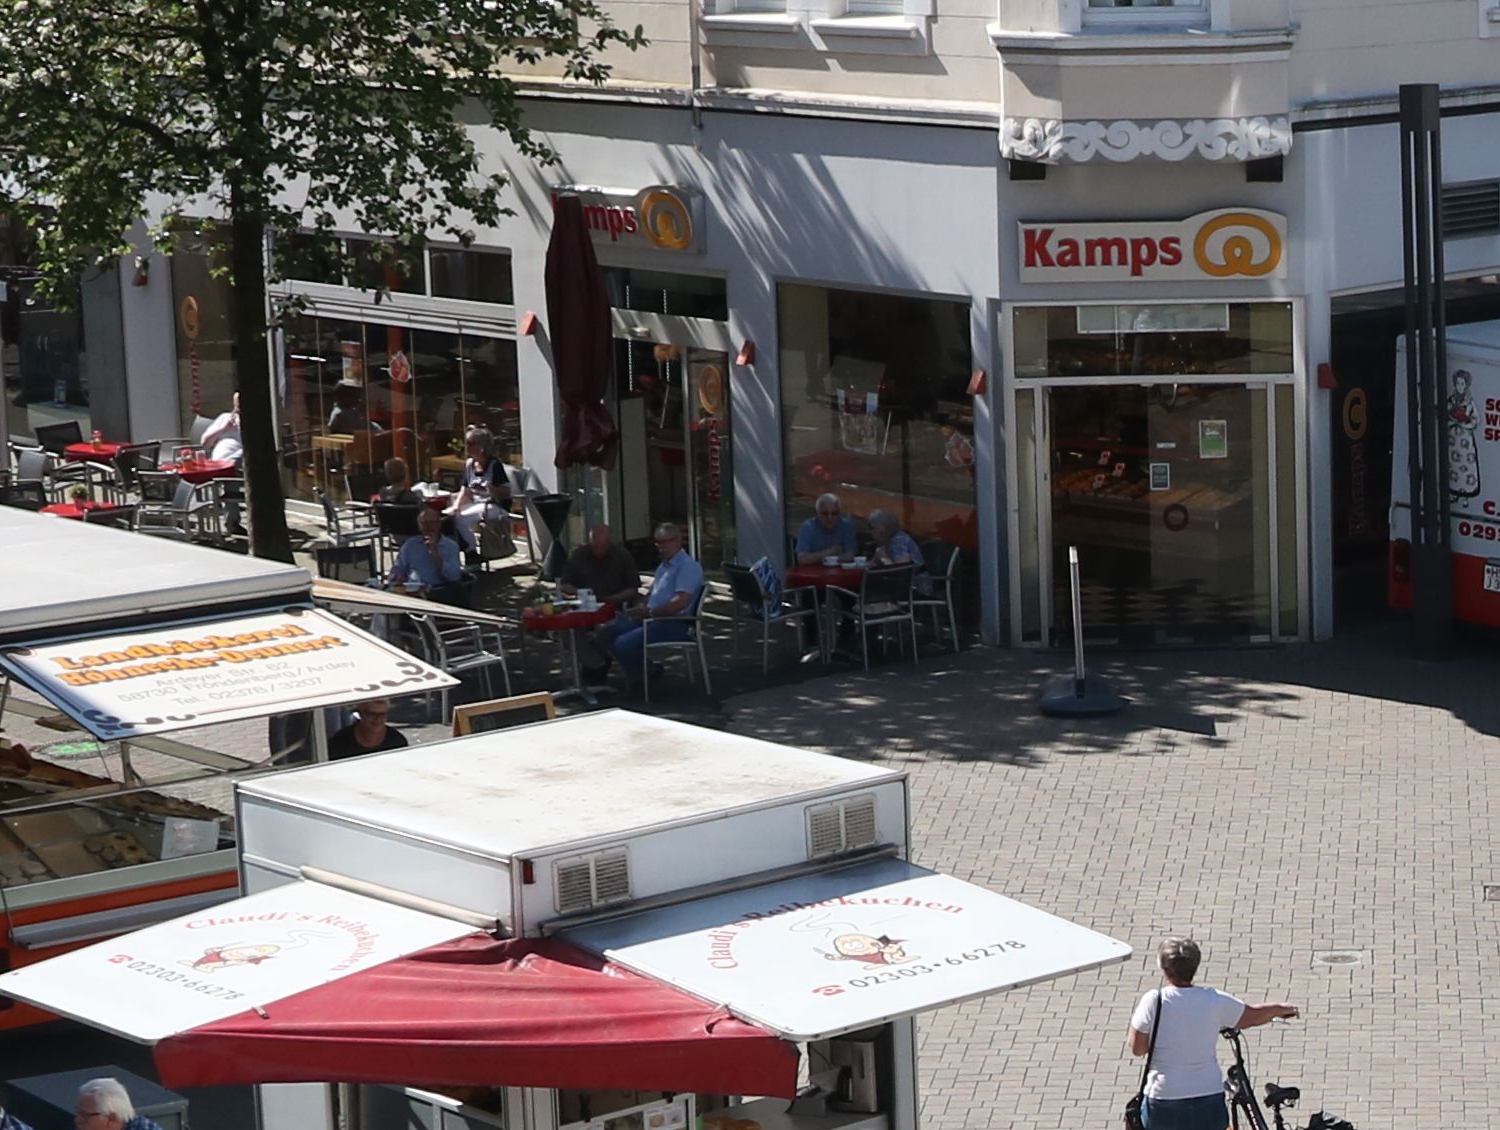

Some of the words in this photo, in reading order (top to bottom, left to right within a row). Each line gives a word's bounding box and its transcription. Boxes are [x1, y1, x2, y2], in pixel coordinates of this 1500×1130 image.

[1023, 228, 1183, 277] Kamps
[52, 624, 314, 670] Landbäckerei
[58, 636, 350, 686] Hönnecke-Deunert
